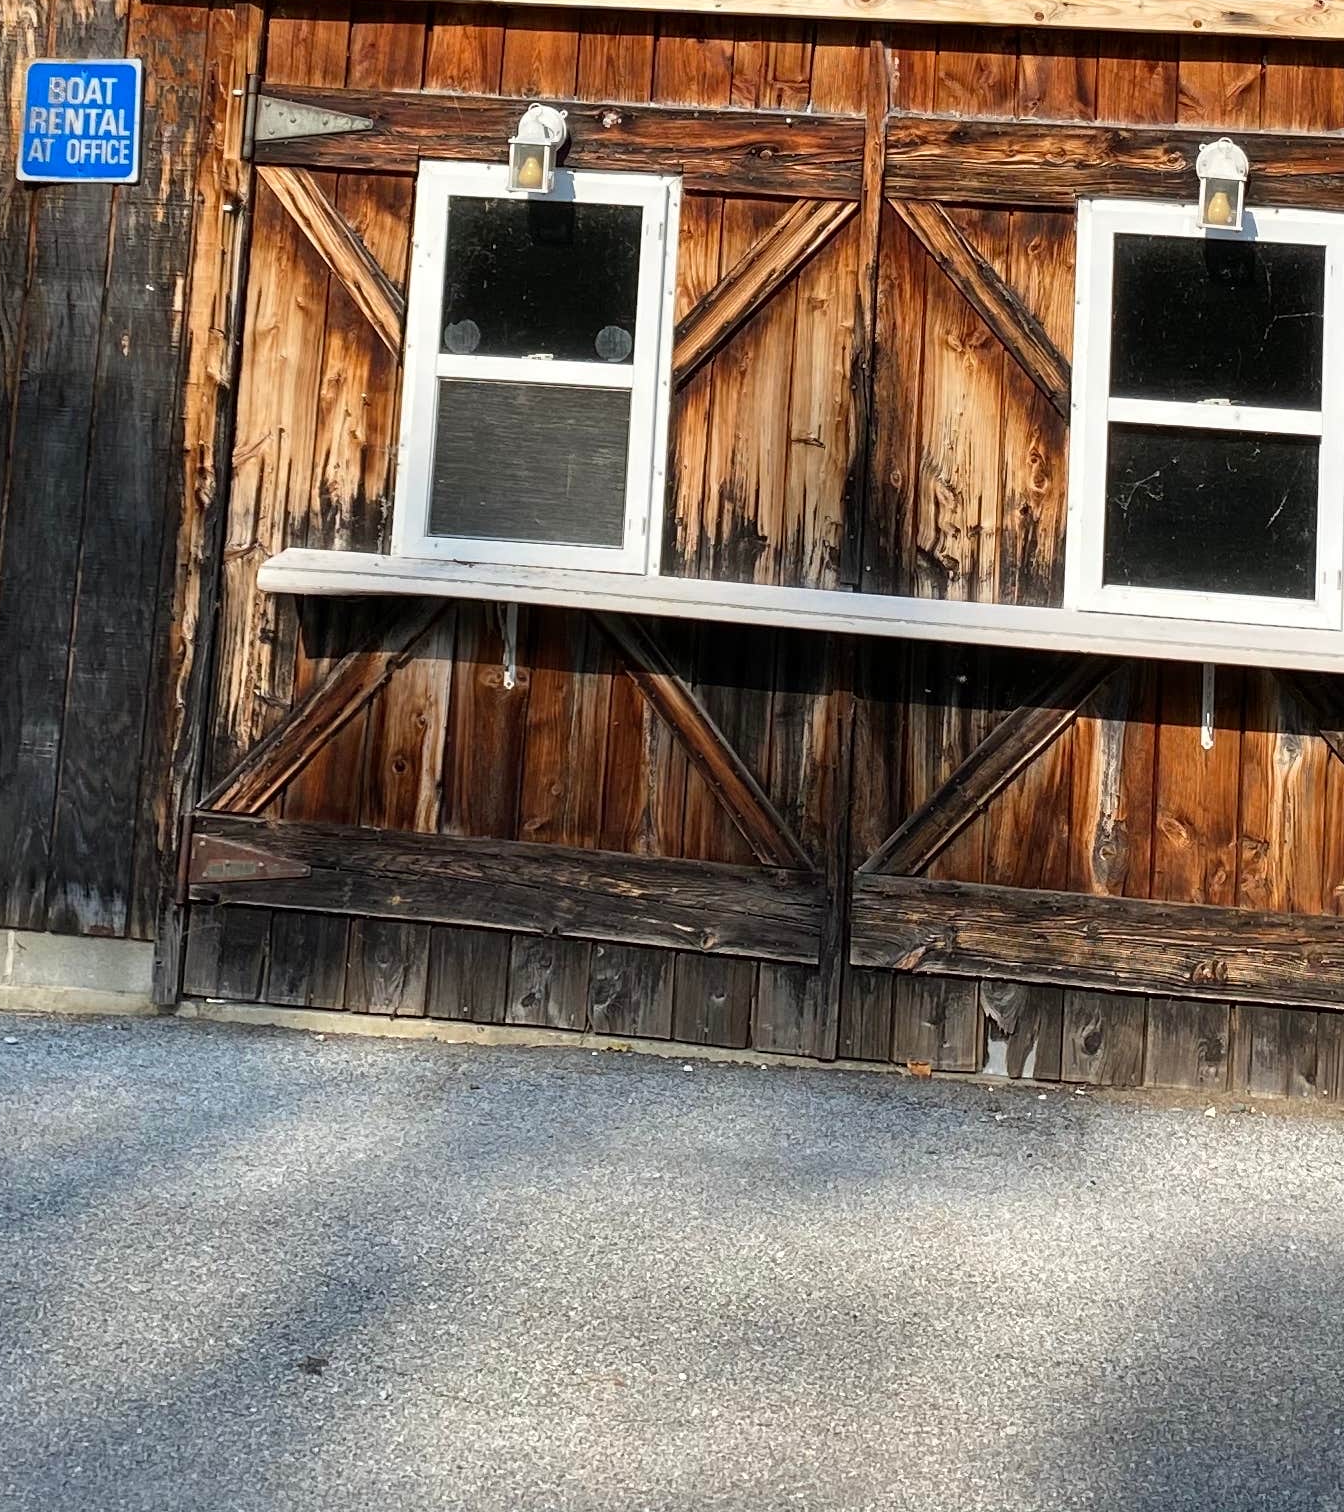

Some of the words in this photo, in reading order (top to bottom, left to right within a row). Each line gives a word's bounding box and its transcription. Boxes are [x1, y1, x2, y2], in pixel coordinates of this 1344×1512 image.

[47, 76, 118, 105] BOAT
[28, 106, 130, 137] RENTAL
[27, 138, 55, 163] AT
[66, 139, 130, 165] OFFICE
